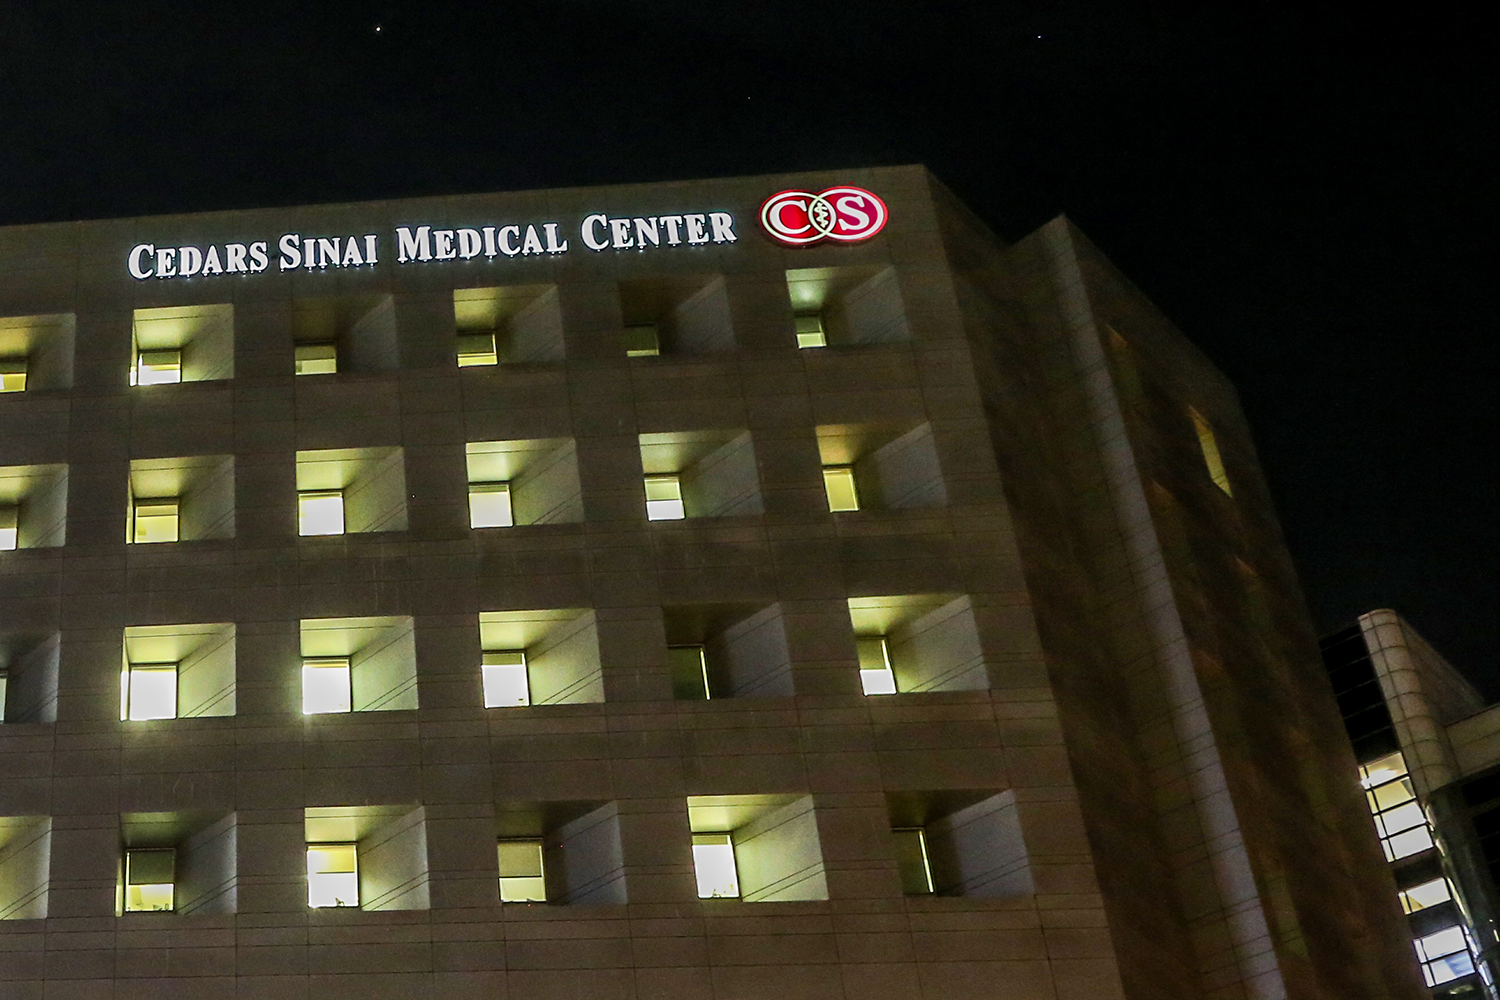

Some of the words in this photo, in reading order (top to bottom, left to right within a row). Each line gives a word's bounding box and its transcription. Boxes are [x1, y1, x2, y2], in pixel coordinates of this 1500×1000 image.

[128, 242, 269, 279] CEDARS
[278, 233, 378, 271] SINAI
[396, 223, 568, 262] MEDICAL
[581, 212, 737, 250] CENTER
